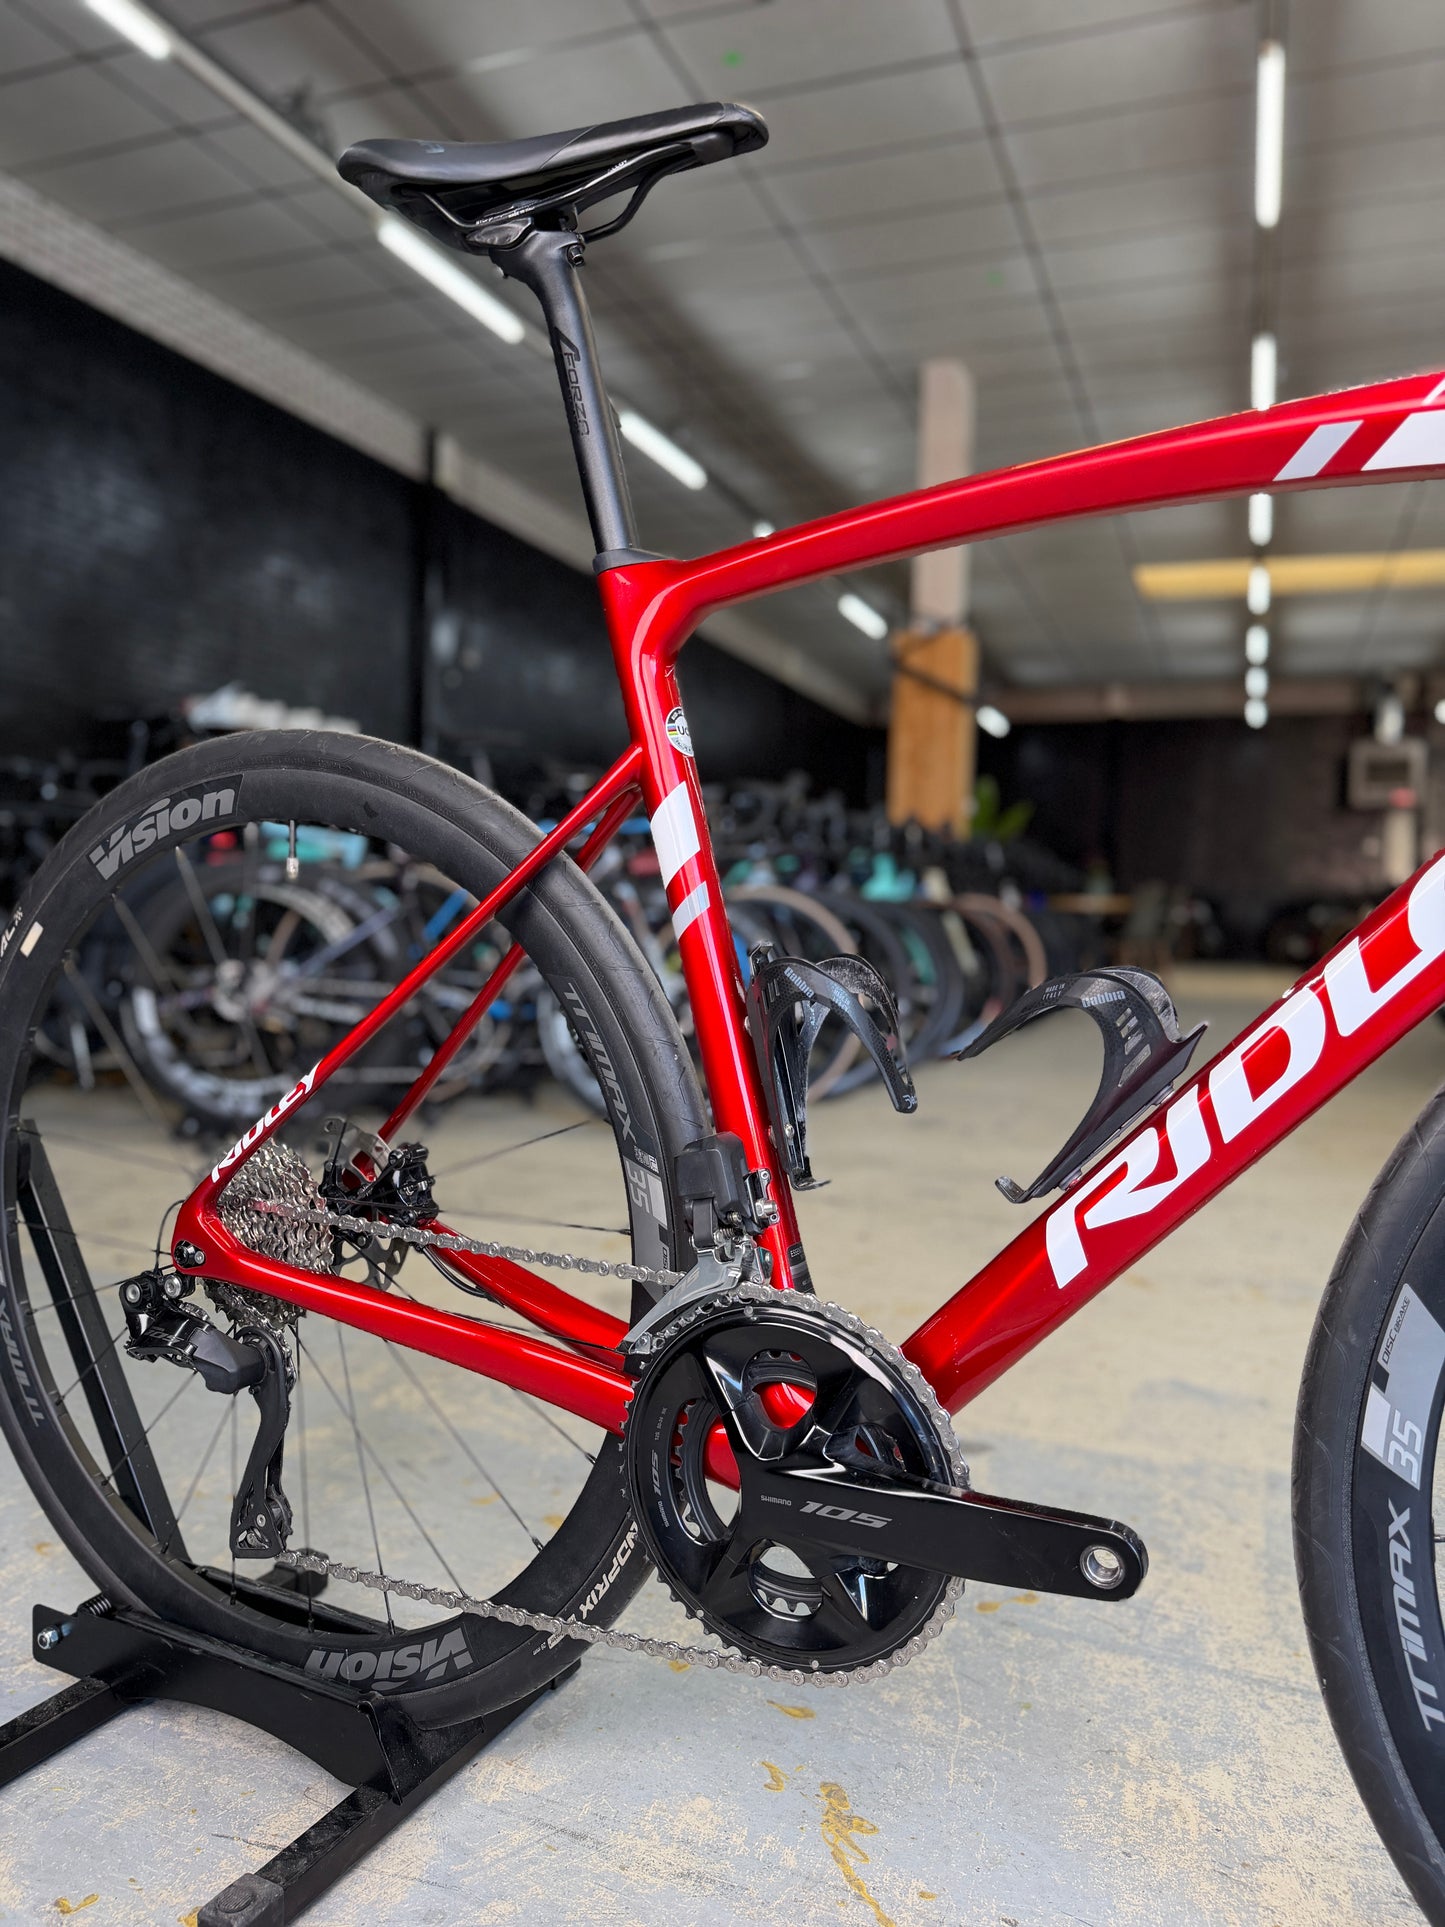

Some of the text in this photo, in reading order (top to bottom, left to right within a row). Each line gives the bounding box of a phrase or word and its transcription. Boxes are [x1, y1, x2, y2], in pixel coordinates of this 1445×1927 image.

[211, 1058, 323, 1183] RIDLEY
[626, 1161, 651, 1214] 35
[1382, 1295, 1411, 1366] DISC BRAKE
[651, 1449, 662, 1496] 105
[1388, 1408, 1422, 1485] 35
[760, 1494, 893, 1528] SHIMANO 105
